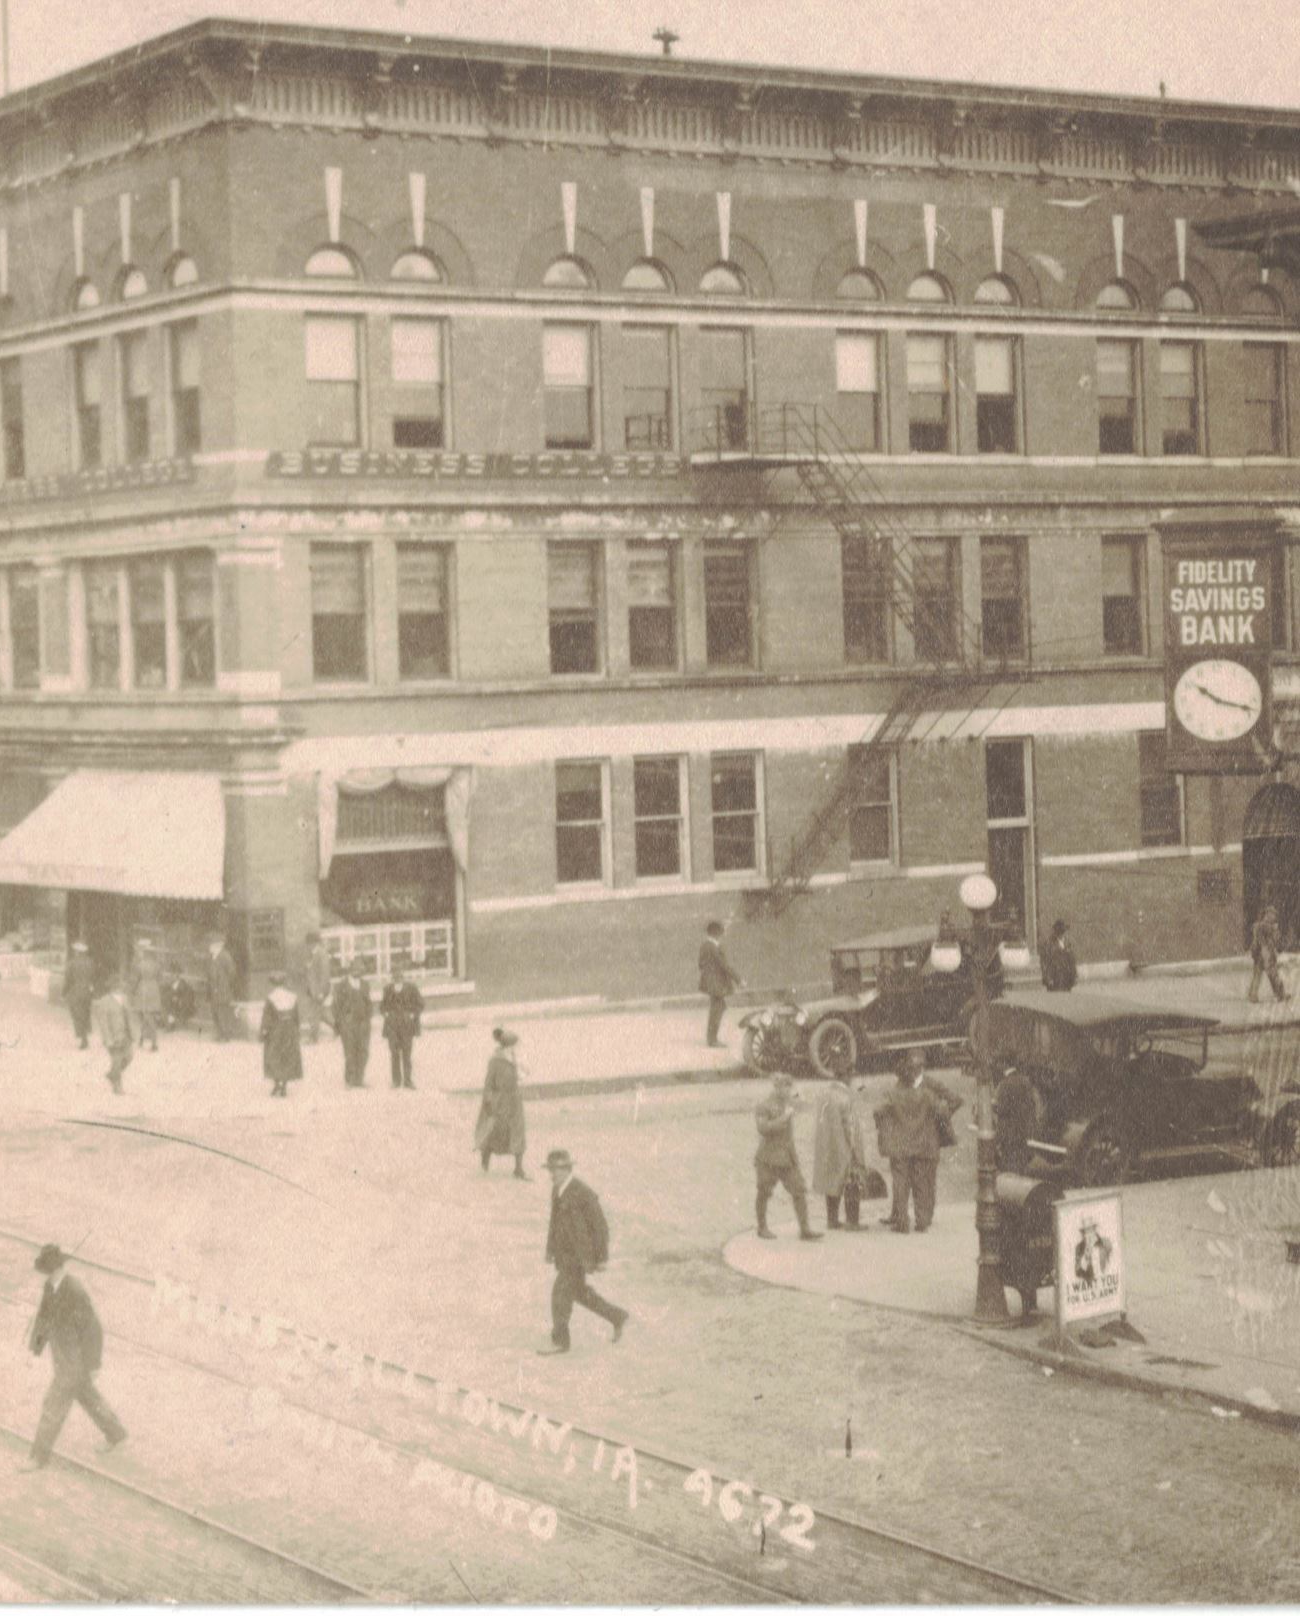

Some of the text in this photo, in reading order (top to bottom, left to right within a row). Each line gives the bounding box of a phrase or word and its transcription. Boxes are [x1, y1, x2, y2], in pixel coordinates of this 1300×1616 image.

[1177, 559, 1256, 585] FIDELITY
[1170, 586, 1266, 612] SAVINGS
[1180, 614, 1255, 645] BANK
[356, 895, 418, 914] BANK
[1073, 1279, 1097, 1292] WANT
[1100, 1273, 1119, 1287] YOU
[1067, 1295, 1080, 1303] FOR
